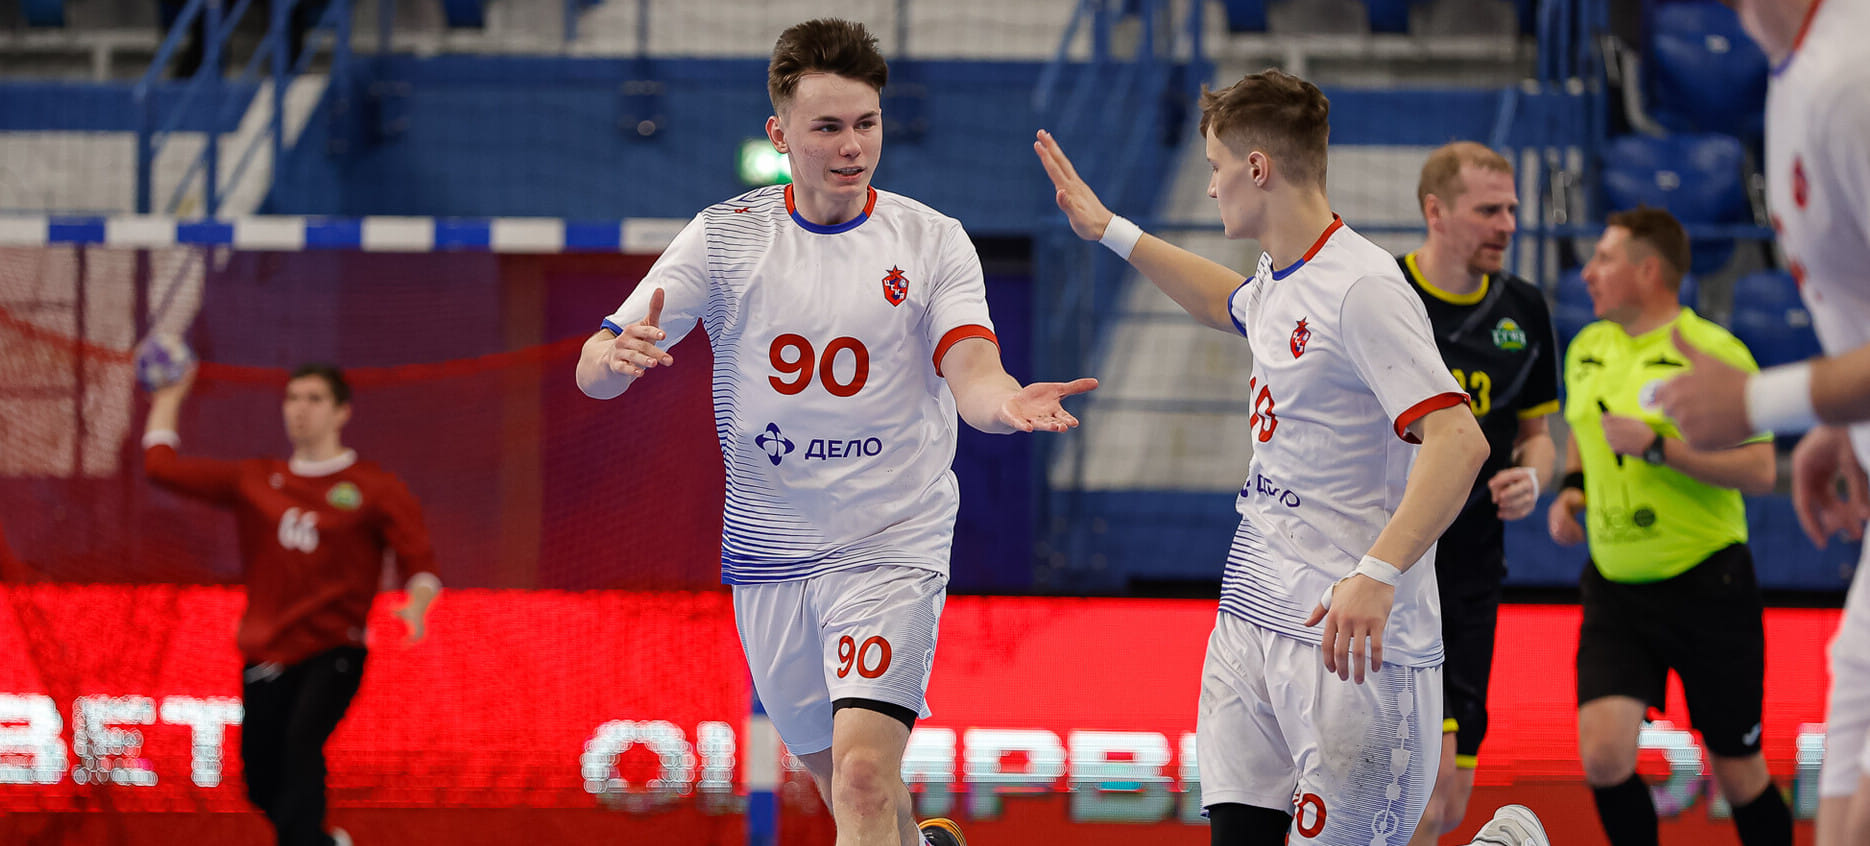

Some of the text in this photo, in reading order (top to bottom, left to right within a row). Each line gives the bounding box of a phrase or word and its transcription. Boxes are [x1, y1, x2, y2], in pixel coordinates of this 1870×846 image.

[768, 333, 870, 398] 90
[1250, 376, 1278, 442] 0
[804, 437, 883, 460] ДЕЛО
[278, 506, 319, 553] 66
[837, 635, 892, 679] 90
[1286, 793, 1327, 842] 0
